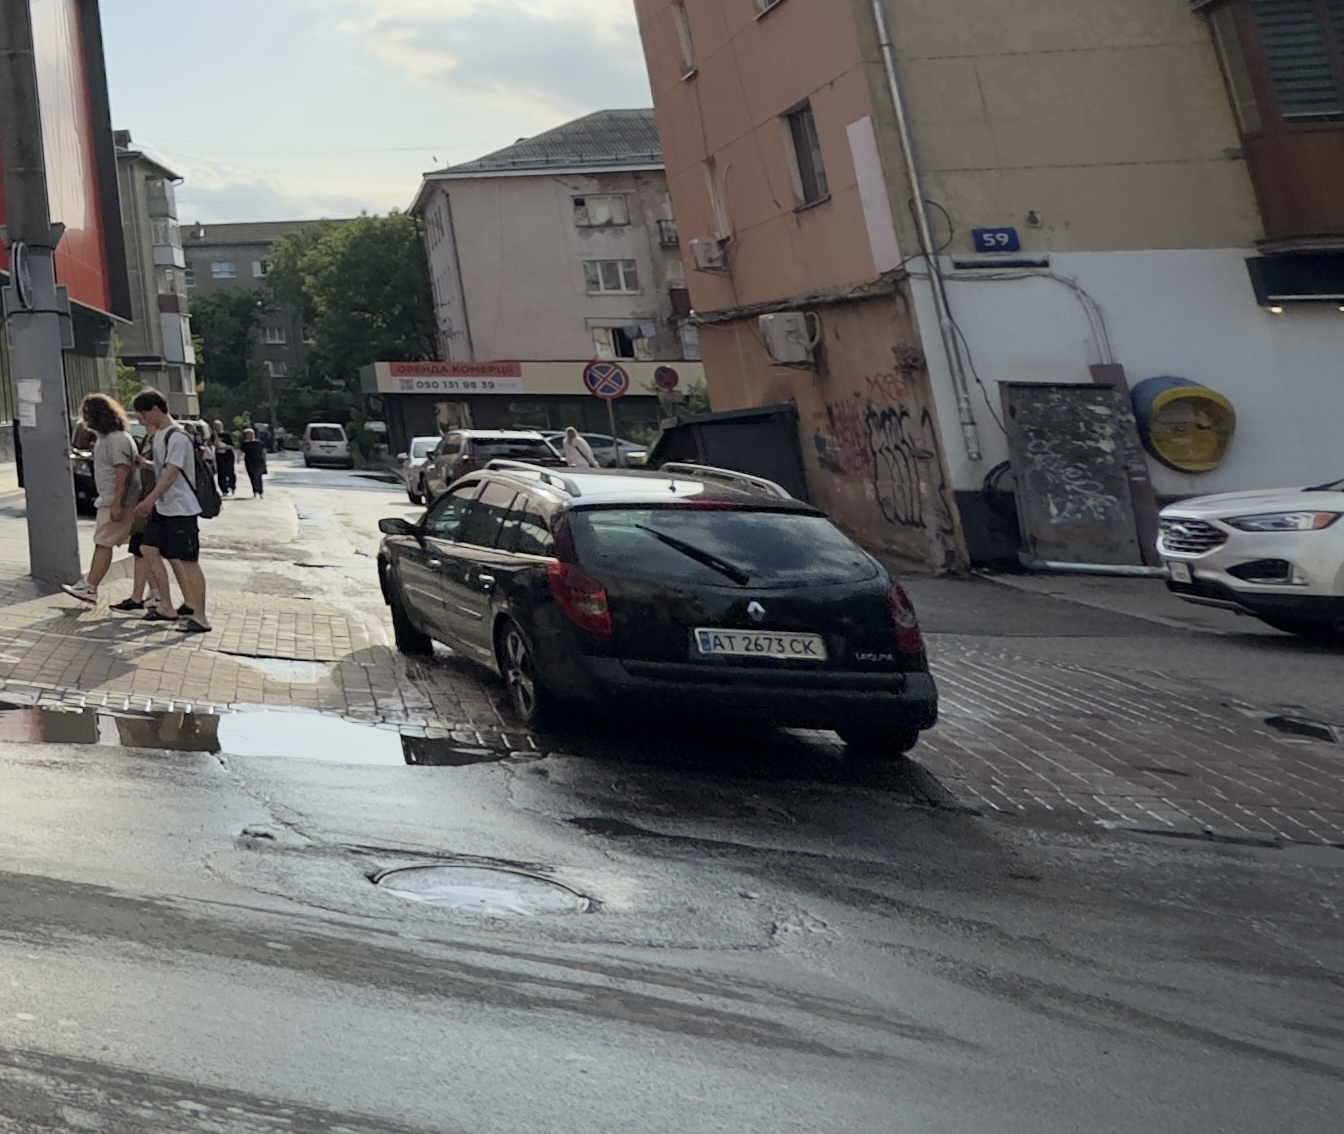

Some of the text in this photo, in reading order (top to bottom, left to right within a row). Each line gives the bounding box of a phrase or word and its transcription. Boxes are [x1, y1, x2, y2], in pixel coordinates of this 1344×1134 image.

[982, 232, 1009, 246] 59
[397, 365, 449, 374] ОРЕНДА
[416, 380, 439, 389] 050
[442, 380, 460, 389] 131
[481, 380, 495, 389] 39
[713, 636, 817, 655] AT 2673 CK
